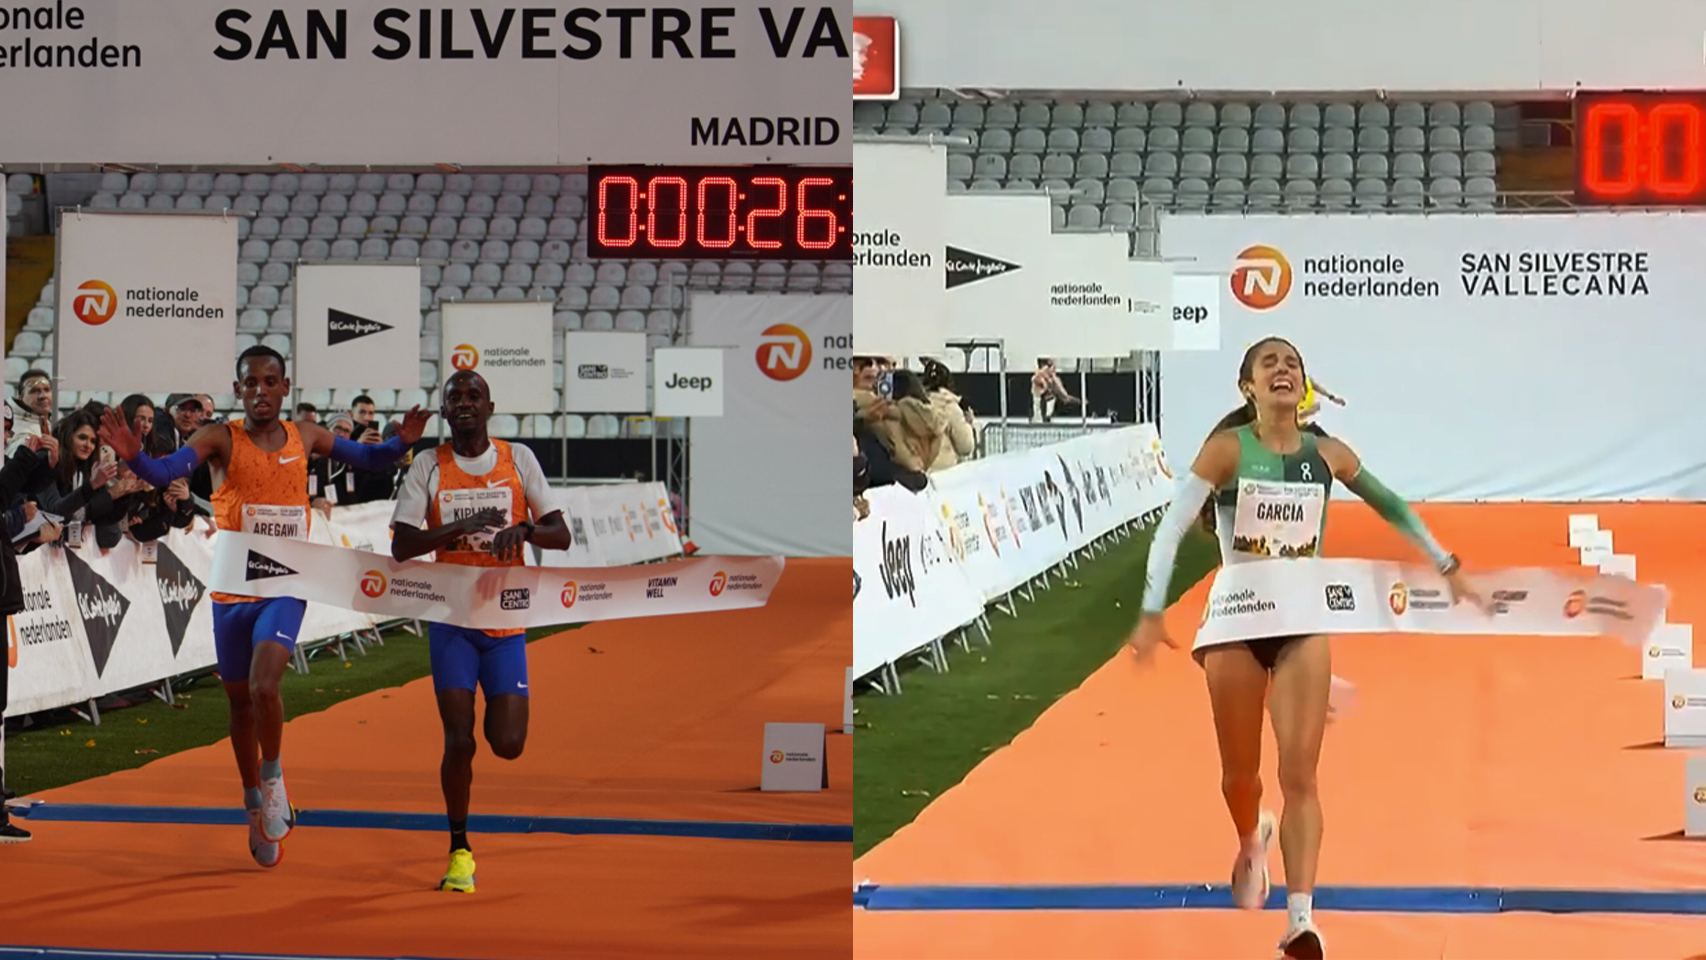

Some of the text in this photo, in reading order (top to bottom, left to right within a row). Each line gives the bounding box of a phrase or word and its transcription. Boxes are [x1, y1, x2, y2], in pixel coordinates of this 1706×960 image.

[213, 7, 850, 60] SAN SILVESTRE VA
[690, 117, 840, 146] MADRID
[1304, 254, 1404, 274] nationale
[1461, 252, 1649, 273] SAN SILVESTRE
[1050, 282, 1102, 294] nationale
[1304, 277, 1440, 297] nederlanden
[1461, 274, 1650, 296] VALLECANA
[126, 287, 199, 301] nationale
[1050, 294, 1121, 306] nederlanden
[126, 304, 224, 318] nederlanden
[484, 347, 530, 356] nationale
[484, 358, 546, 367] nederlanden
[665, 373, 713, 392] Jeep
[1257, 502, 1304, 522] GARCIA
[253, 521, 299, 538] AREGAWI
[879, 520, 916, 609] Jeep
[391, 578, 433, 591] nationale
[647, 576, 678, 588] VITAMIN
[730, 574, 757, 582] nationale
[580, 583, 606, 591] nationale
[646, 588, 665, 599] WELL
[726, 582, 763, 591] nederlanden
[390, 587, 446, 602] nederlanden
[503, 590, 523, 600] SANI
[579, 592, 613, 602] nederlanden
[20, 614, 73, 647] nederlanden
